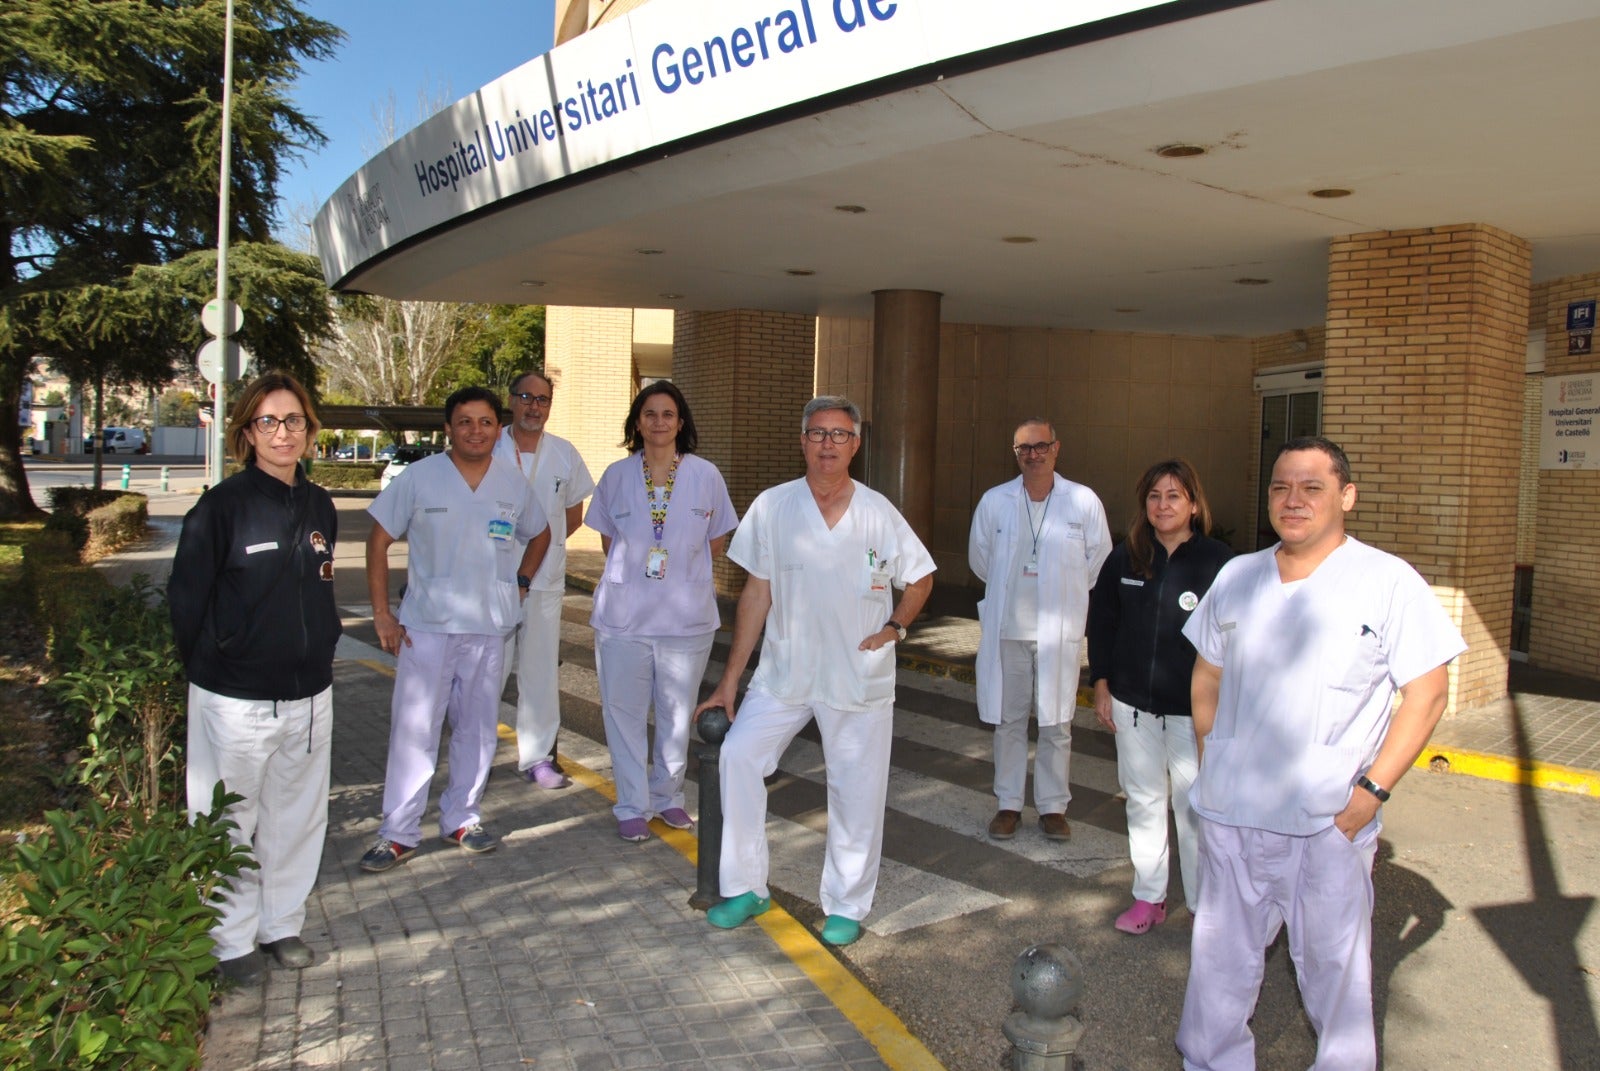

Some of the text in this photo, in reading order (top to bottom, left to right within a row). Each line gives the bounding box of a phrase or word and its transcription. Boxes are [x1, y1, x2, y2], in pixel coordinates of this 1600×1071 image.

[414, 130, 487, 197] Hospital
[485, 59, 641, 162] Universitari
[652, 0, 816, 94] General
[1549, 406, 1600, 417] Hospital General
[1565, 428, 1590, 437] Castelló
